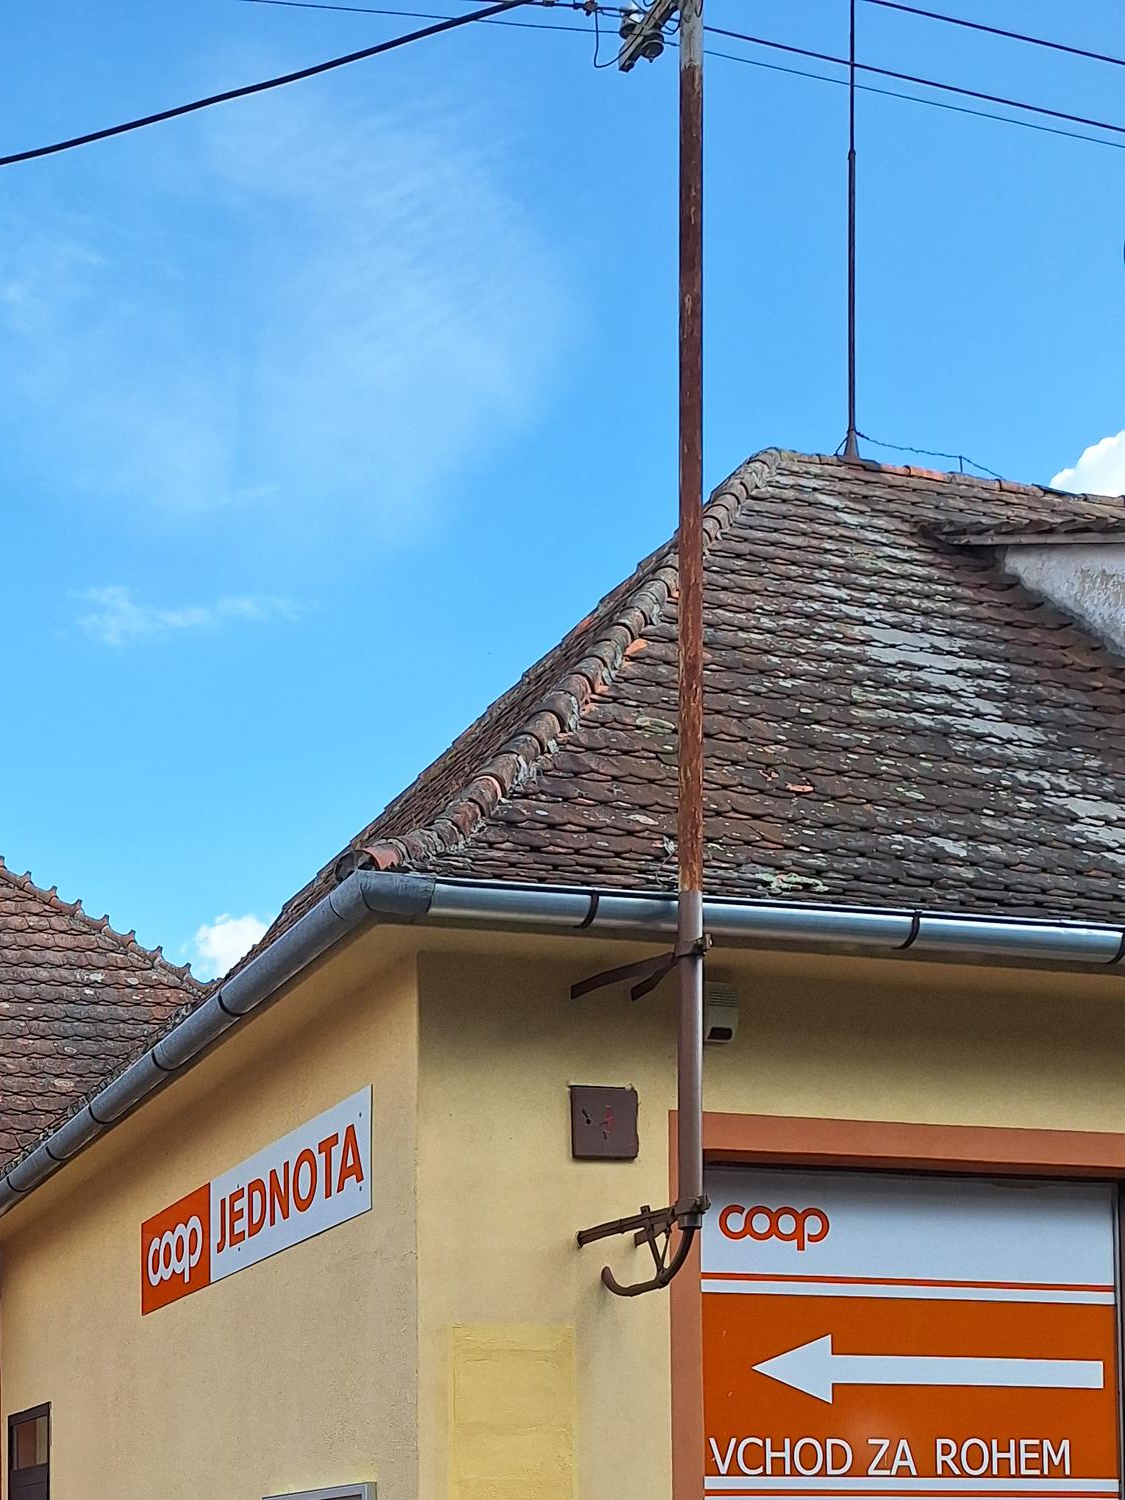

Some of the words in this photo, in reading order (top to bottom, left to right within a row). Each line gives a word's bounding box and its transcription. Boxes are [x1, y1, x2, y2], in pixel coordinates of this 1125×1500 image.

[147, 1215, 203, 1287] coop
[216, 1123, 365, 1255] JEDNOTA
[718, 1204, 830, 1252] coop
[708, 1436, 854, 1476] VCHOD
[867, 1437, 918, 1477] ZA
[935, 1437, 1072, 1477] ROHEM
